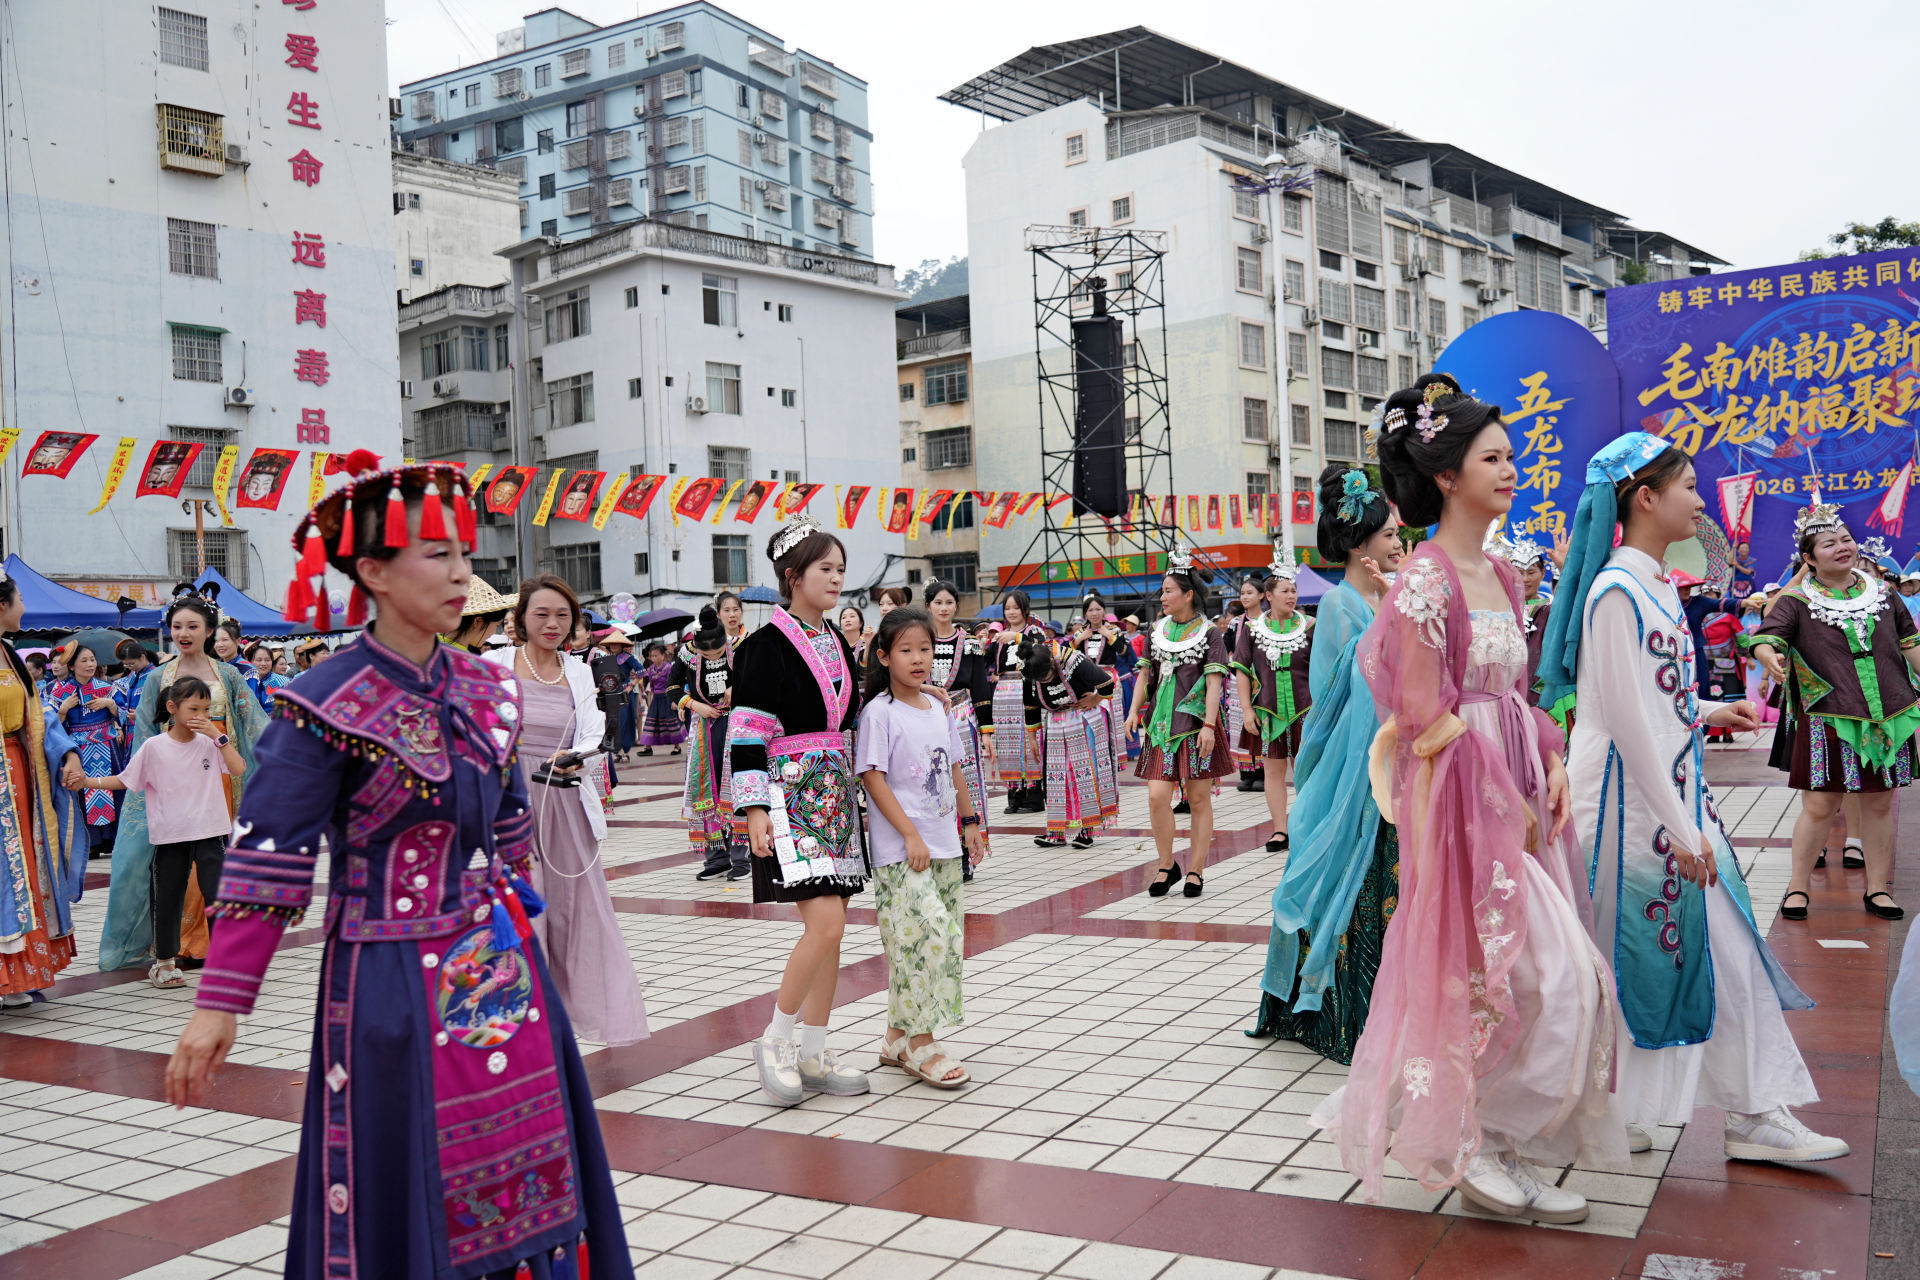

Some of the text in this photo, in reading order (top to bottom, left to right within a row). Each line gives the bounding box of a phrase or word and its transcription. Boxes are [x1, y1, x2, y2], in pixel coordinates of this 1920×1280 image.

[291, 230, 331, 444] 远离毒品
[1637, 319, 1920, 406] 毛南傩韵启新
[1501, 371, 1575, 535] 五龙布雨
[1754, 478, 1796, 495] 026
